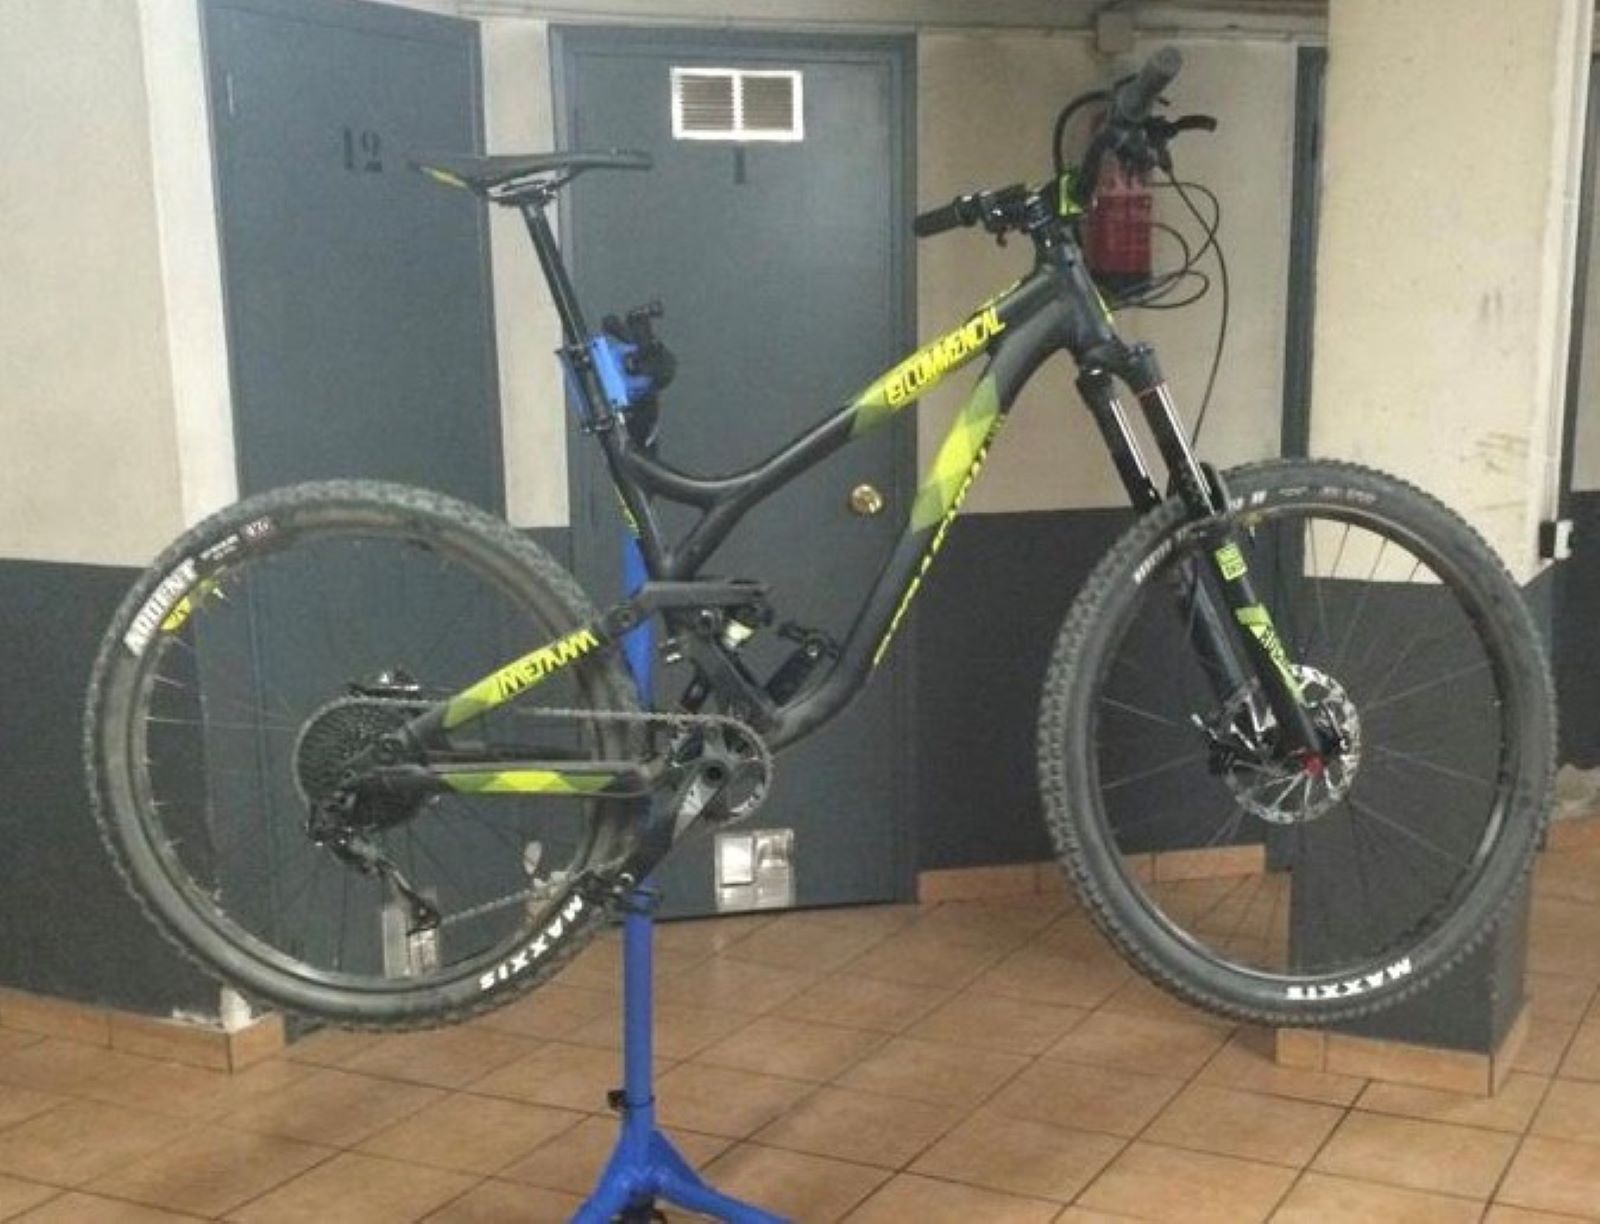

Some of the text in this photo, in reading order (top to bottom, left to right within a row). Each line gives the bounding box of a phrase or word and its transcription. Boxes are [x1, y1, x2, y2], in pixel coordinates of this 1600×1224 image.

[343, 127, 383, 173] 12
[480, 894, 583, 990] MAXXIS
[1286, 957, 1412, 1000] MAXXIS
